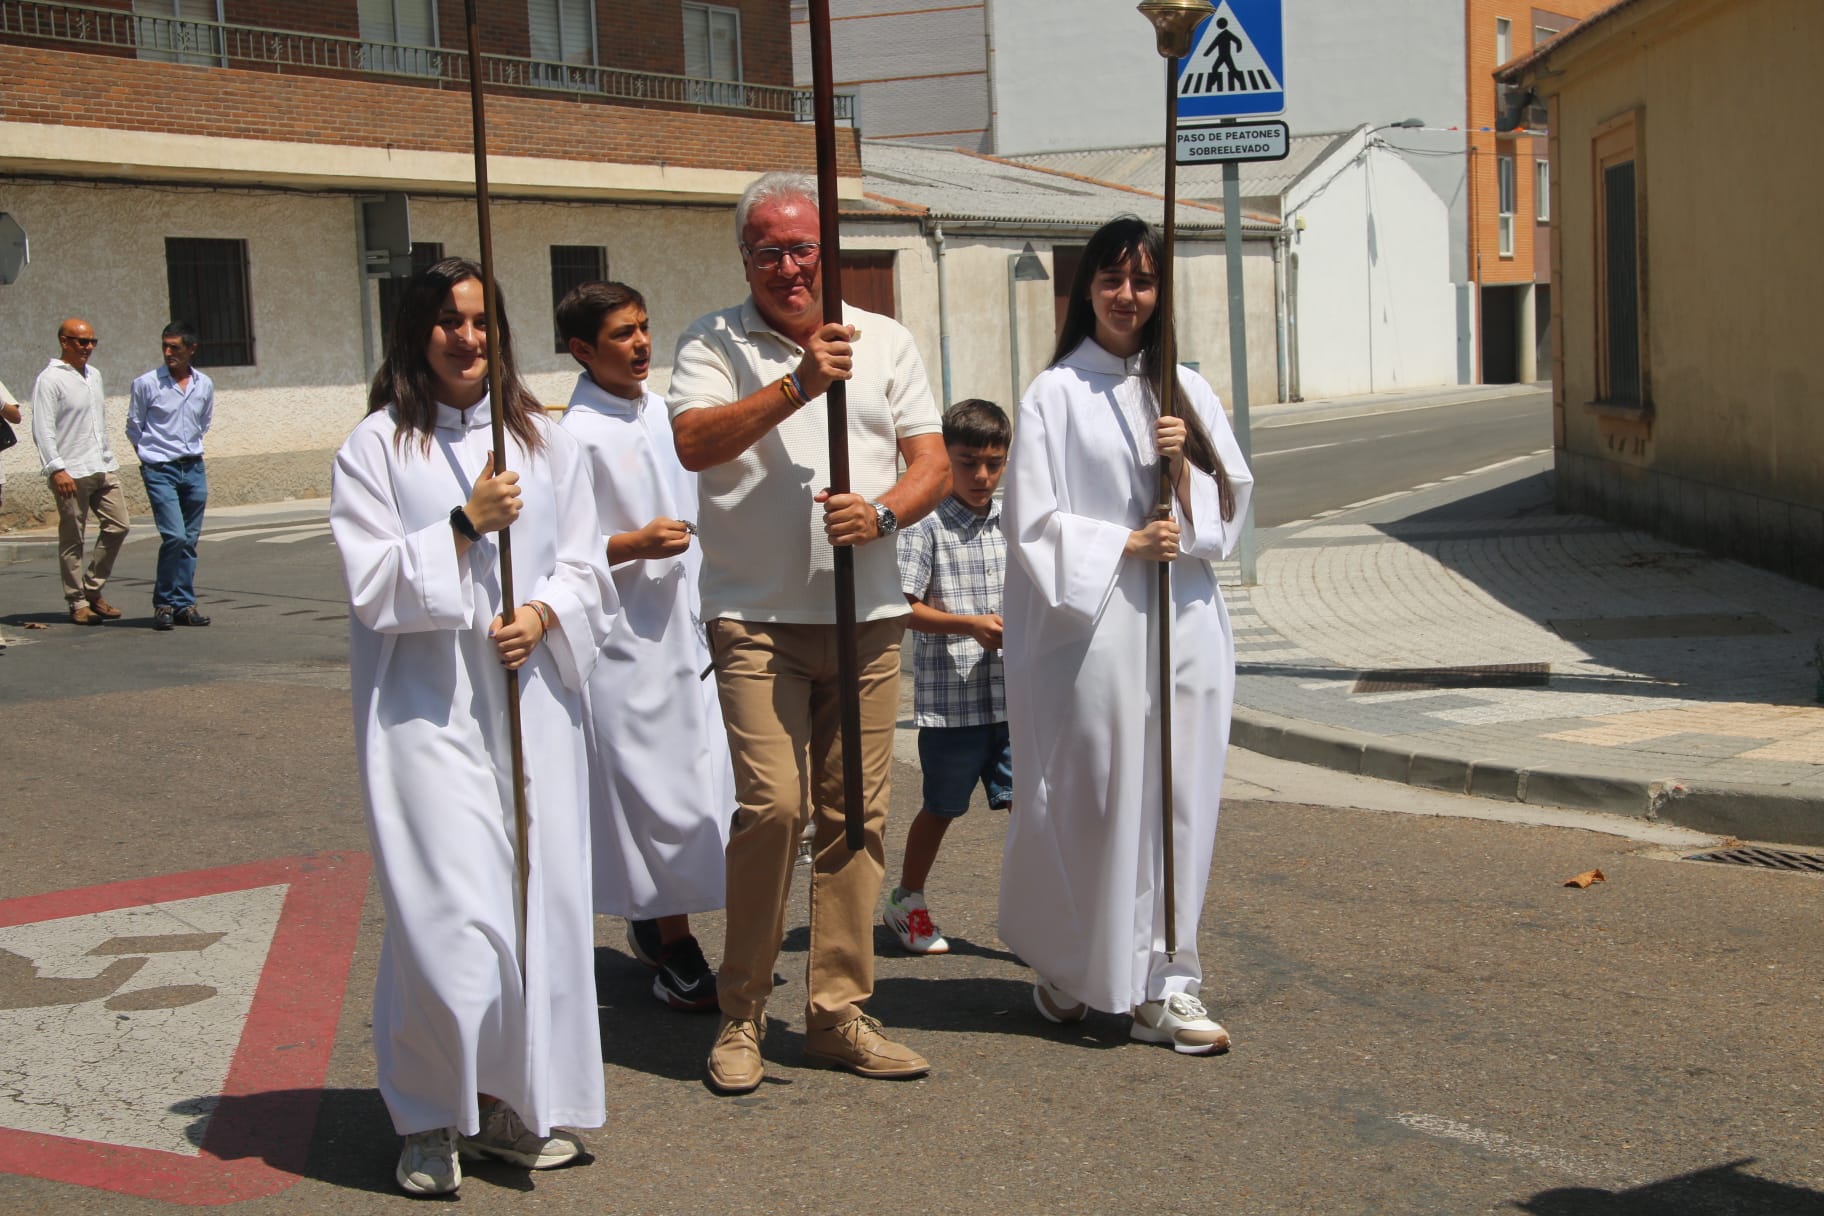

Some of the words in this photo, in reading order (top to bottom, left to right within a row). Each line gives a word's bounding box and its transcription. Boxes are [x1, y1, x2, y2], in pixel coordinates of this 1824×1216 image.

[1177, 133, 1205, 142] PASO
[1208, 132, 1222, 141] DE
[1225, 129, 1280, 140] PEATONES
[1189, 144, 1270, 156] SOBREELEVADO
